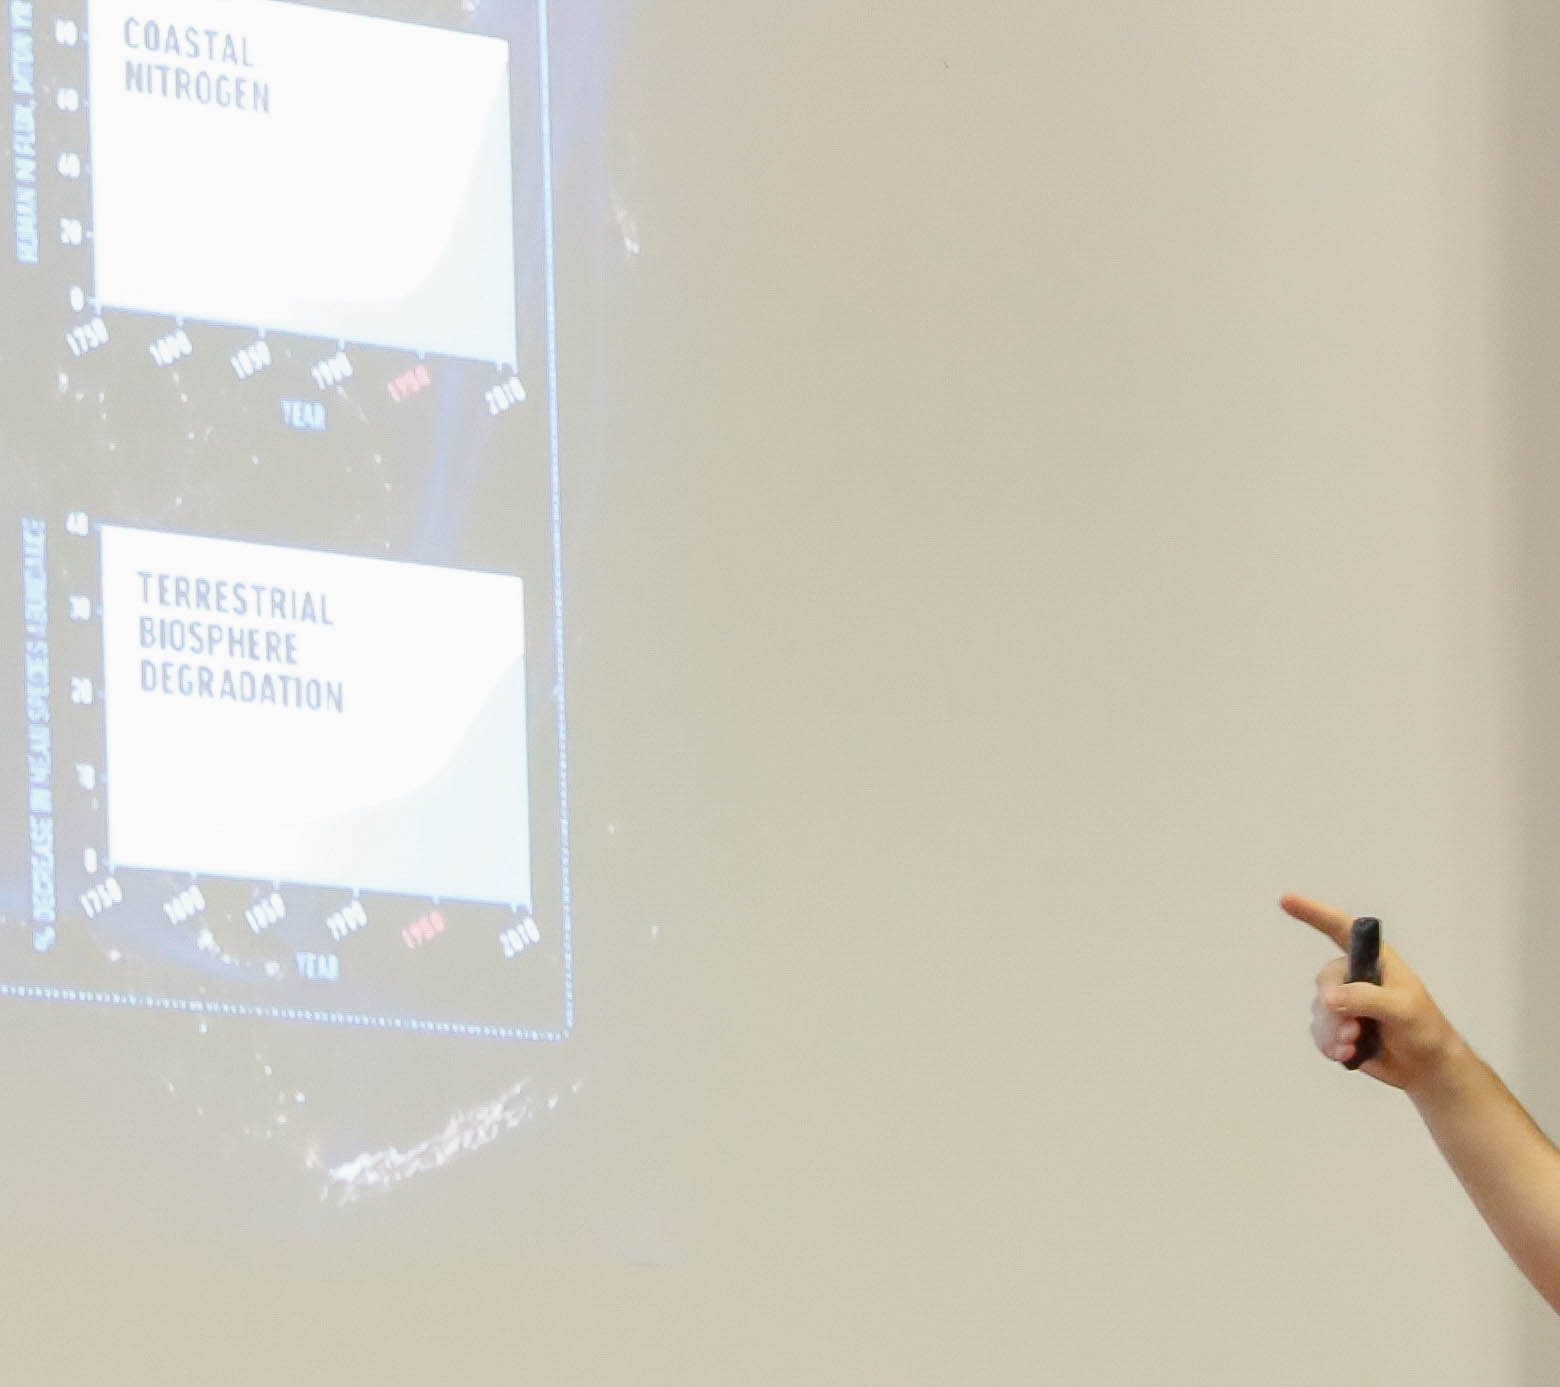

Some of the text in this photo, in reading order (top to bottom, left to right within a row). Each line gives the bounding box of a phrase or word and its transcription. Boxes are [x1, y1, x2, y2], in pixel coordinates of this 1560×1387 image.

[123, 16, 256, 69] COASTAL
[123, 59, 271, 115] NITROGEN
[280, 397, 327, 432] YEAR
[137, 570, 334, 627] TERRESTRIAL
[138, 614, 299, 666] BIOSPHERE
[139, 658, 345, 714] DEGRADATION
[295, 951, 339, 982] YEAR
